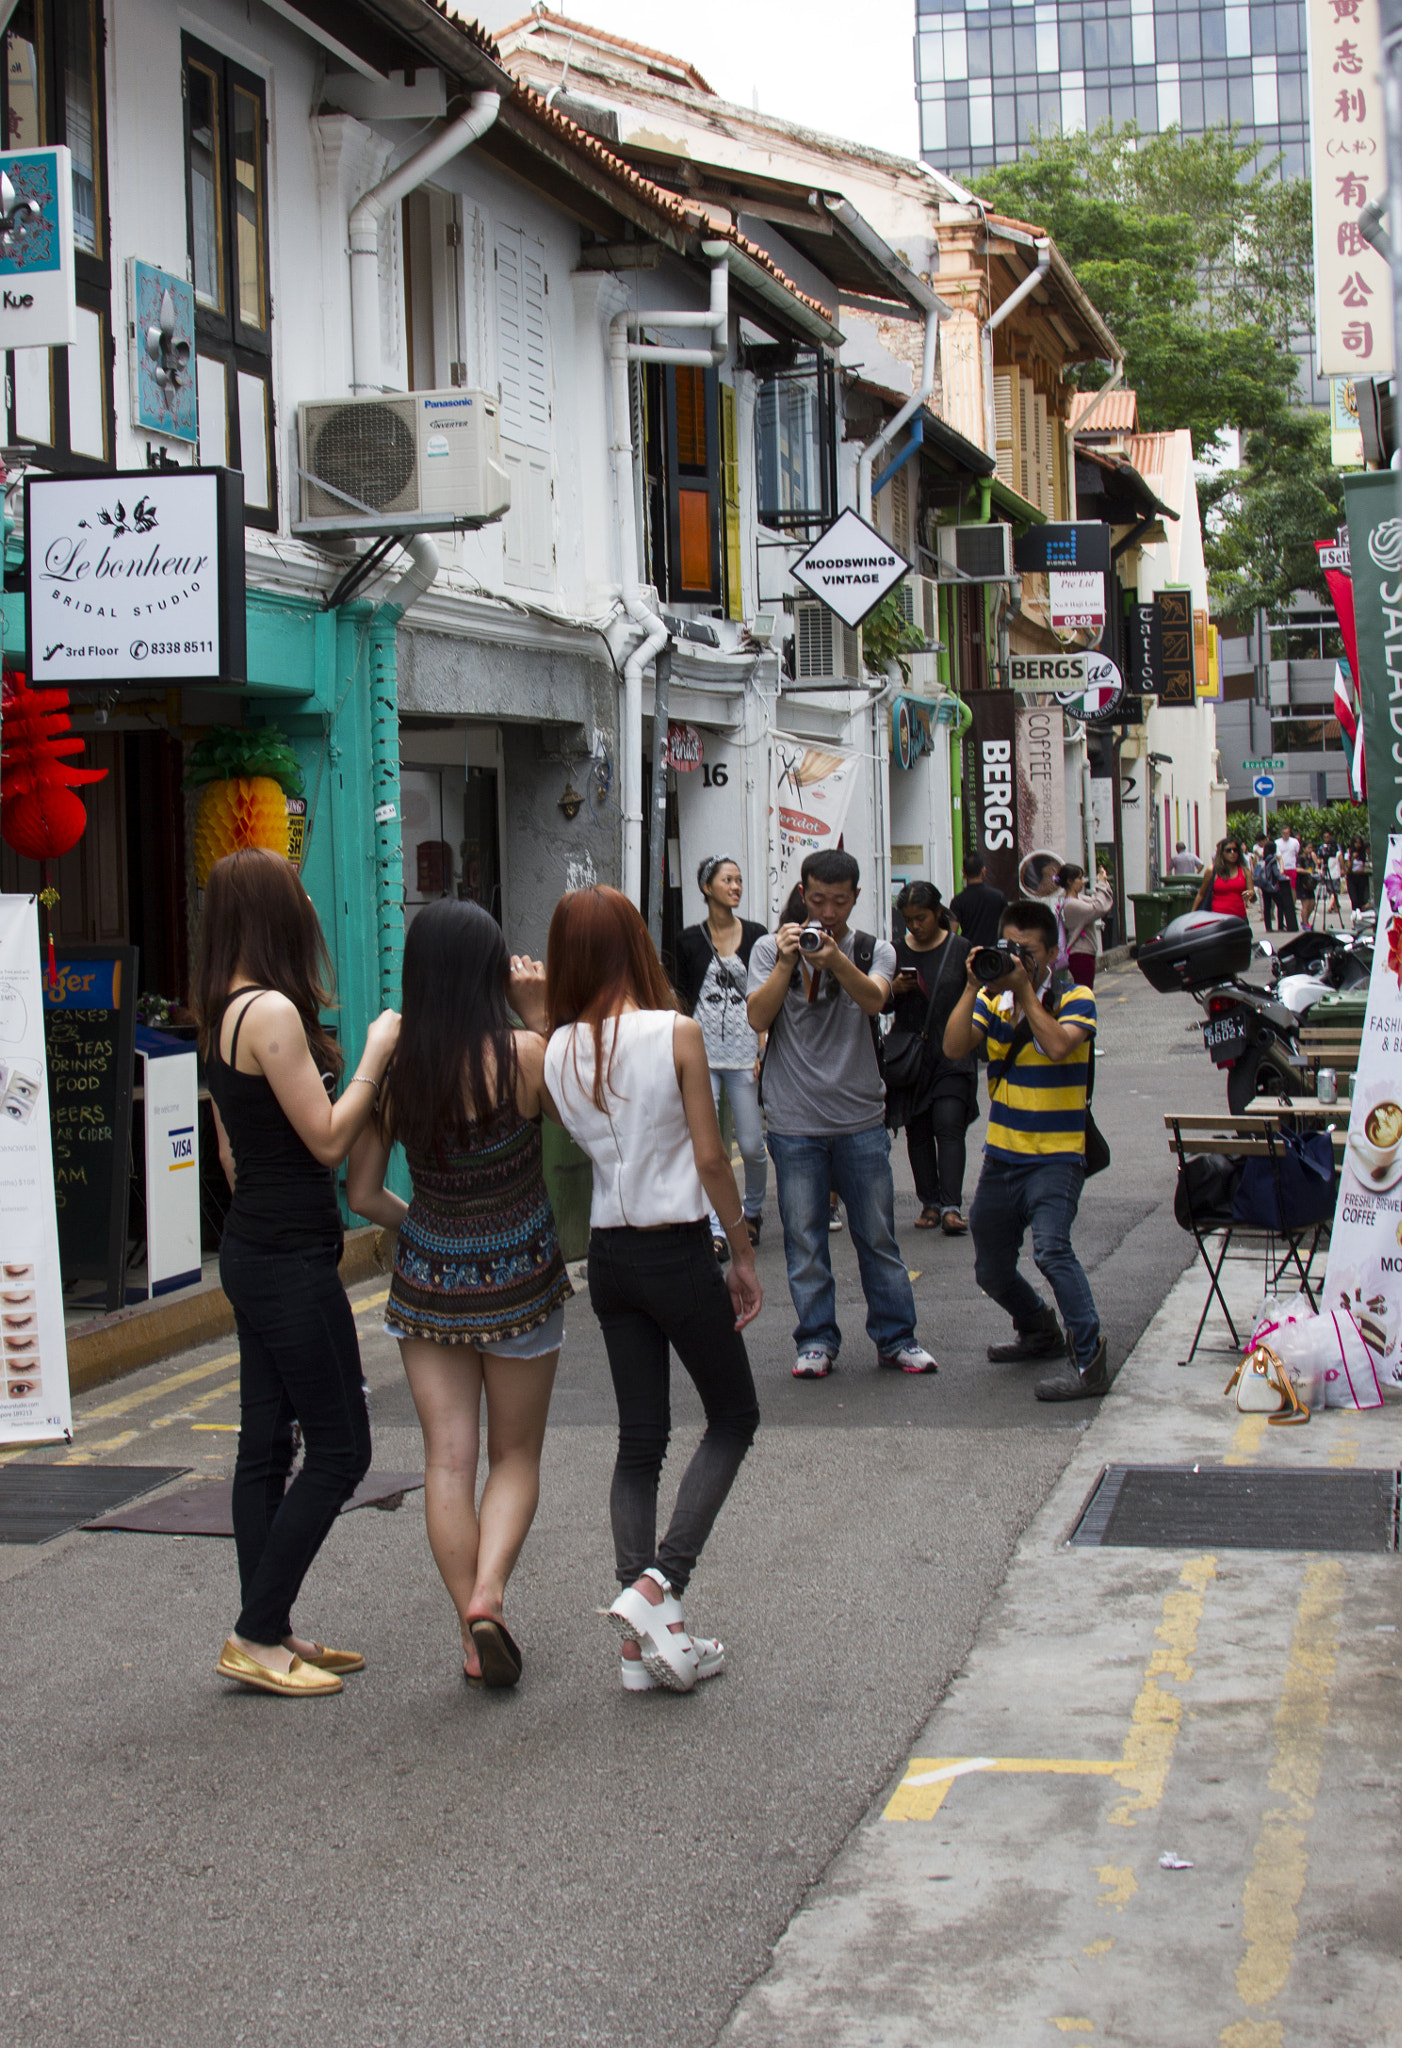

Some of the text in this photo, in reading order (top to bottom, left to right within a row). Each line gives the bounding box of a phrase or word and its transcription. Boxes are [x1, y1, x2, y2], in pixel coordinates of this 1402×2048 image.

[3, 290, 34, 309] Kue
[424, 397, 473, 409] Panasonic
[805, 556, 895, 570] MOODSWINGS
[822, 573, 879, 586] VINTAGE
[1061, 578, 1095, 589] Pte Ltd
[52, 582, 200, 618] BRIDAL STUDIO
[1064, 615, 1092, 626] 02-02
[66, 641, 213, 657] 3rd Floor 8338 8511
[1011, 660, 1084, 680] BERGS
[1028, 714, 1052, 781] COFFEE
[702, 762, 728, 787] 16
[967, 741, 977, 852] GOURMET BURGERS
[982, 740, 1014, 852] BERGS
[1121, 776, 1140, 803] 2
[43, 965, 96, 1003] iger
[51, 1009, 108, 1023] CAKES
[1370, 1015, 1402, 1033] FASHI
[76, 1040, 112, 1056] TEAS
[1382, 1036, 1389, 1052] &
[51, 1057, 107, 1072] DRINKS
[55, 1076, 100, 1093] FOOD
[51, 1105, 105, 1125] EERS
[79, 1126, 112, 1142] CIDER
[172, 1139, 192, 1158] VISA
[1344, 1192, 1376, 1209] FRESHLY
[1342, 1207, 1376, 1226] COFFEE
